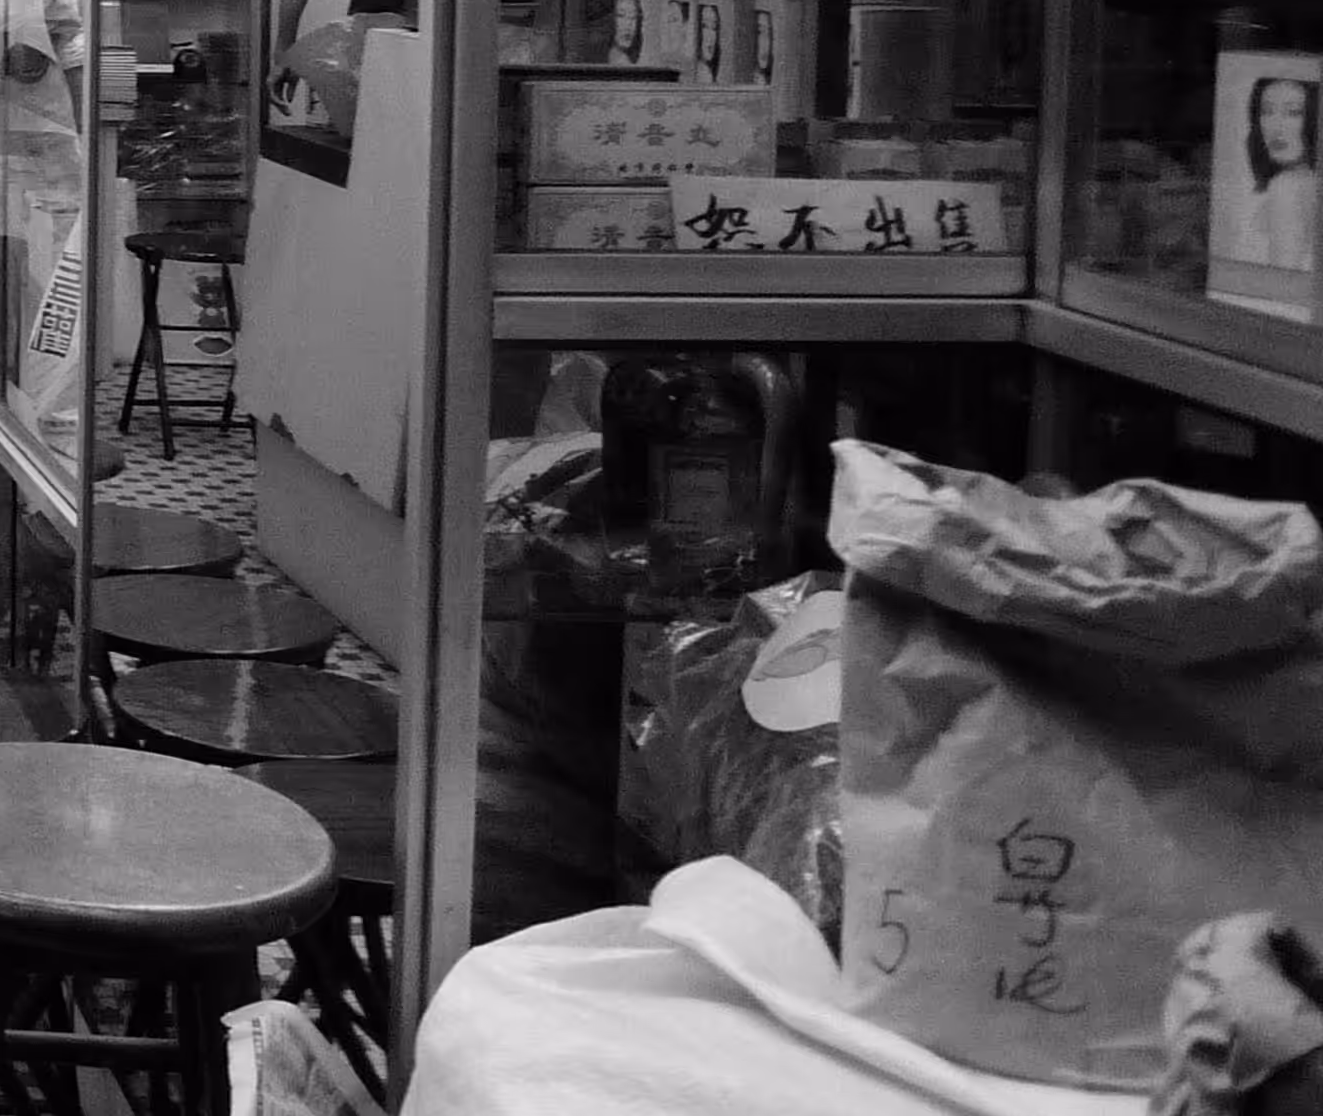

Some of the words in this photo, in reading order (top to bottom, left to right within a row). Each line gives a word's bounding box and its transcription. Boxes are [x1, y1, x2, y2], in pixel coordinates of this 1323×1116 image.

[684, 193, 979, 252] 恕不出售
[873, 888, 910, 975] 5
